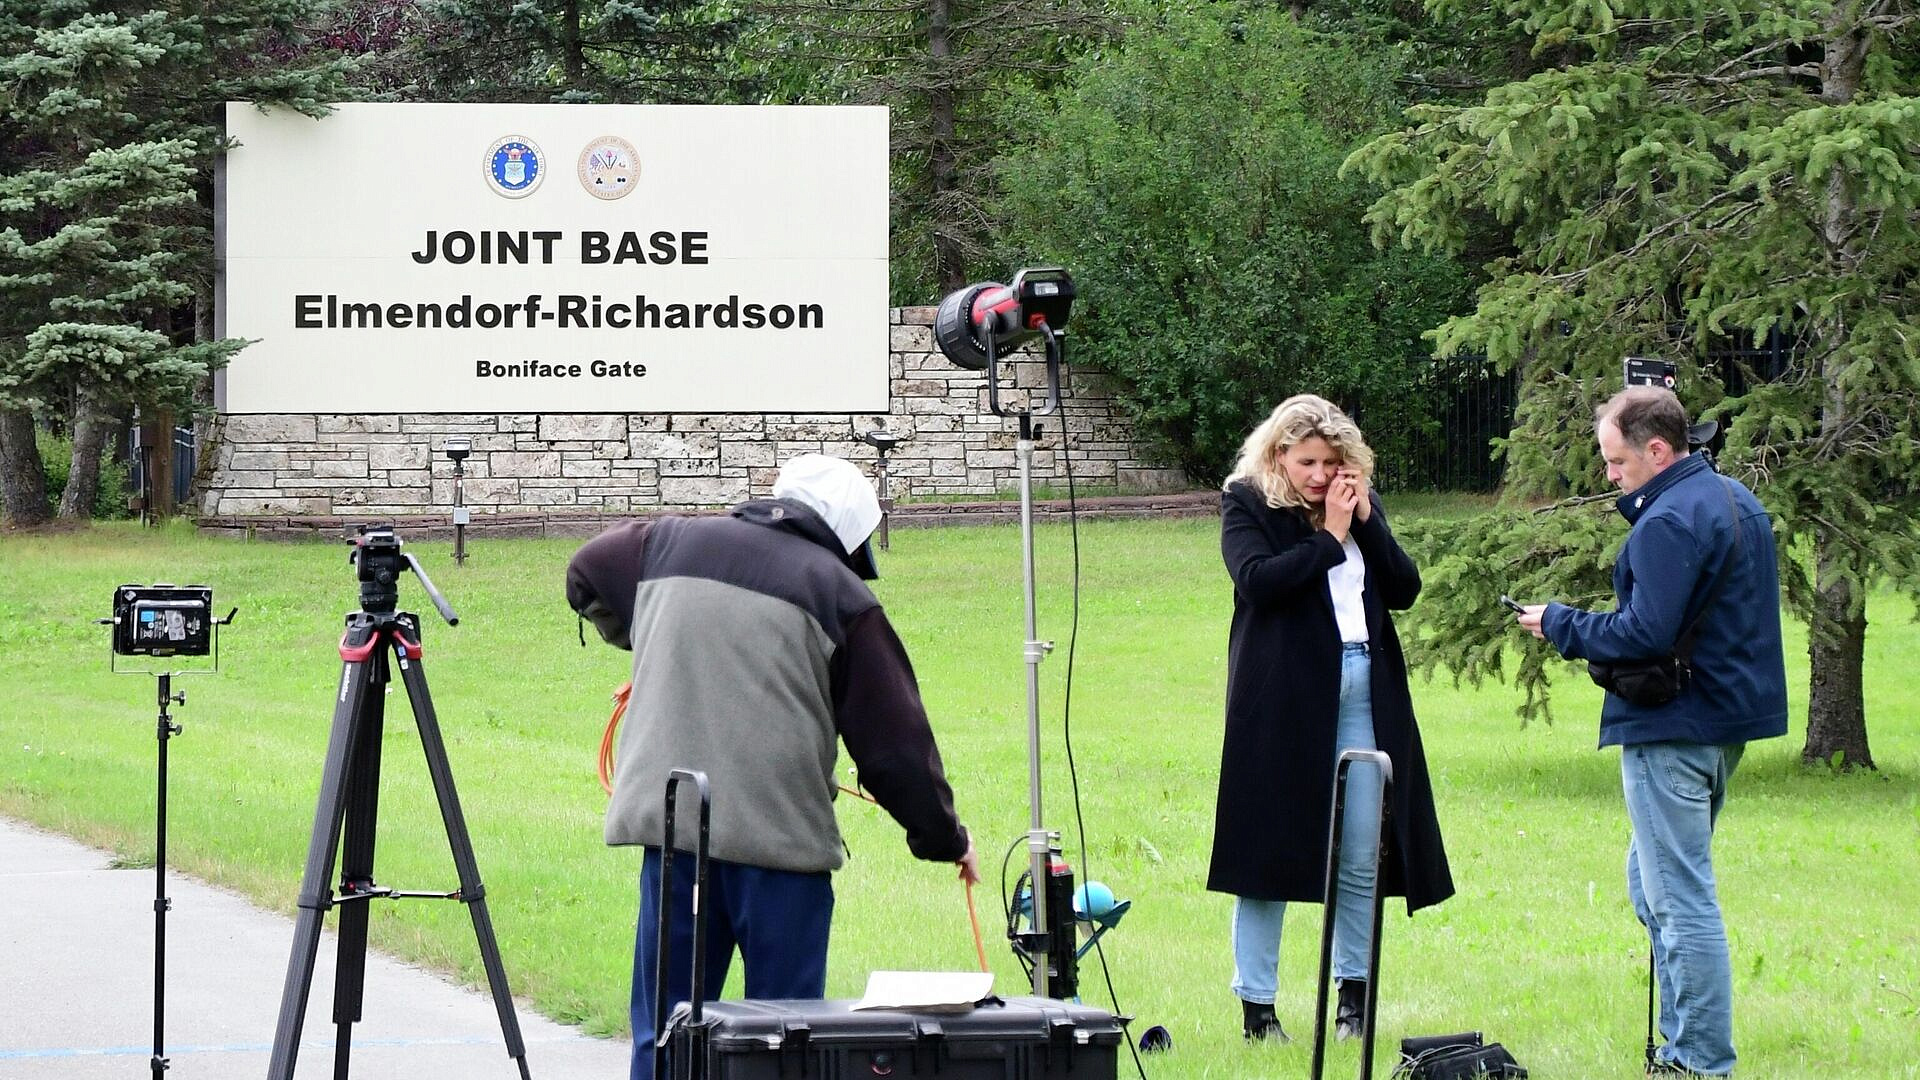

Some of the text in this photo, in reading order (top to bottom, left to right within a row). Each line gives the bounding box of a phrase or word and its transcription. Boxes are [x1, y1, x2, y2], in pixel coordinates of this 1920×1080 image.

[412, 231, 708, 264] JOINT BASE
[296, 295, 824, 329] Elmendorf-Richardson
[476, 360, 646, 377] Boniface Gate
